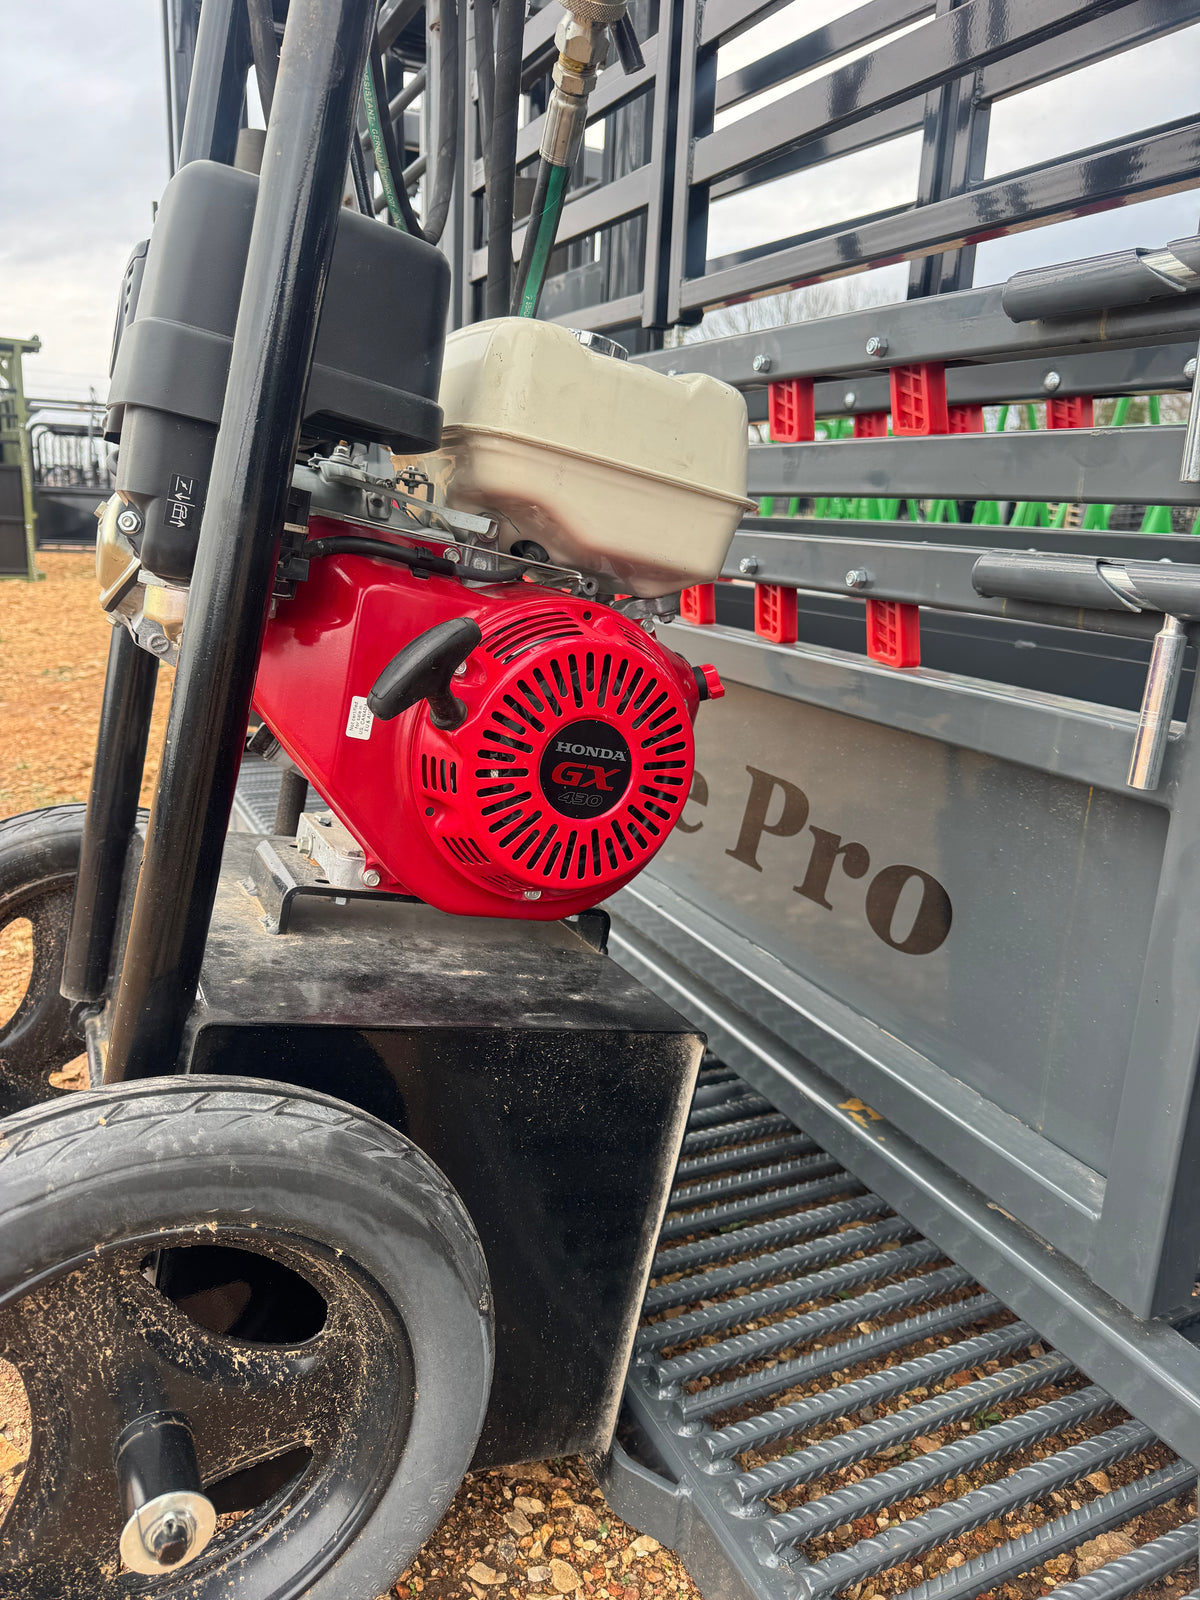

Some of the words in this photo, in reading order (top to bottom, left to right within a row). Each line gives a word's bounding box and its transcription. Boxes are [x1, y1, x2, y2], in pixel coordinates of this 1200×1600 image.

[372, 128, 384, 164] GERMAN
[555, 741, 626, 762] HONDA
[551, 762, 621, 791] GX
[725, 764, 953, 956] Pro
